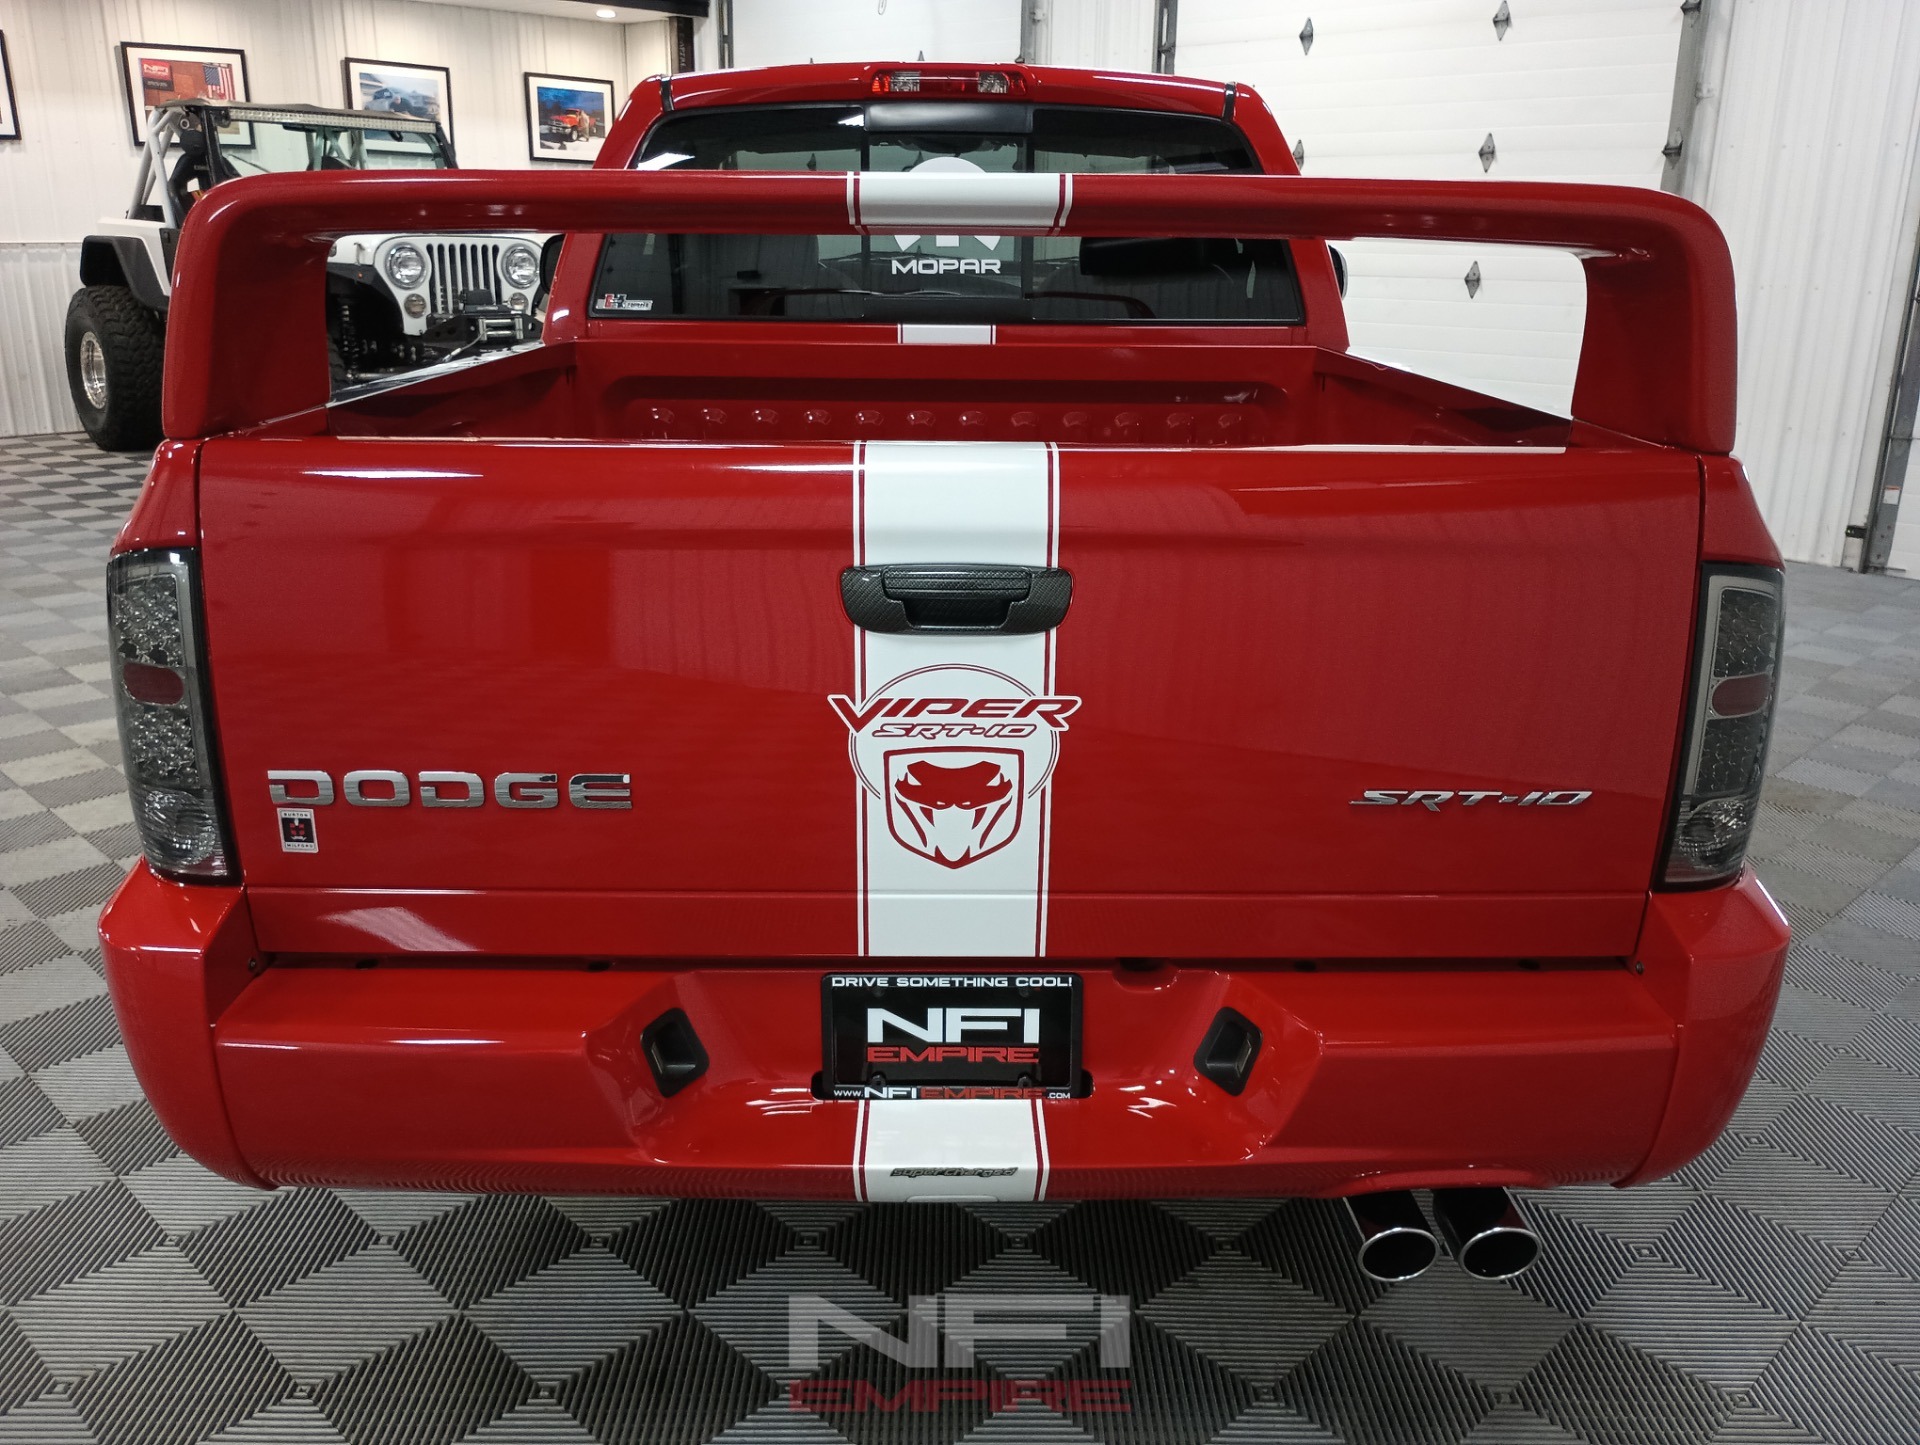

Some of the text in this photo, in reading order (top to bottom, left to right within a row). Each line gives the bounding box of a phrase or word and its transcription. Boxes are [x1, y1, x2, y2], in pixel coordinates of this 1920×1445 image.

[891, 259, 1001, 275] MOPAR
[828, 695, 1082, 734] VIPER
[871, 723, 1037, 740] SRT-10
[267, 770, 633, 809] DODGE
[1349, 790, 1593, 812] SRT-10
[831, 977, 1073, 988] DRIVE SOMETHING COOL!
[867, 1008, 1040, 1044] NFI
[867, 1046, 1040, 1063] EMPIRE
